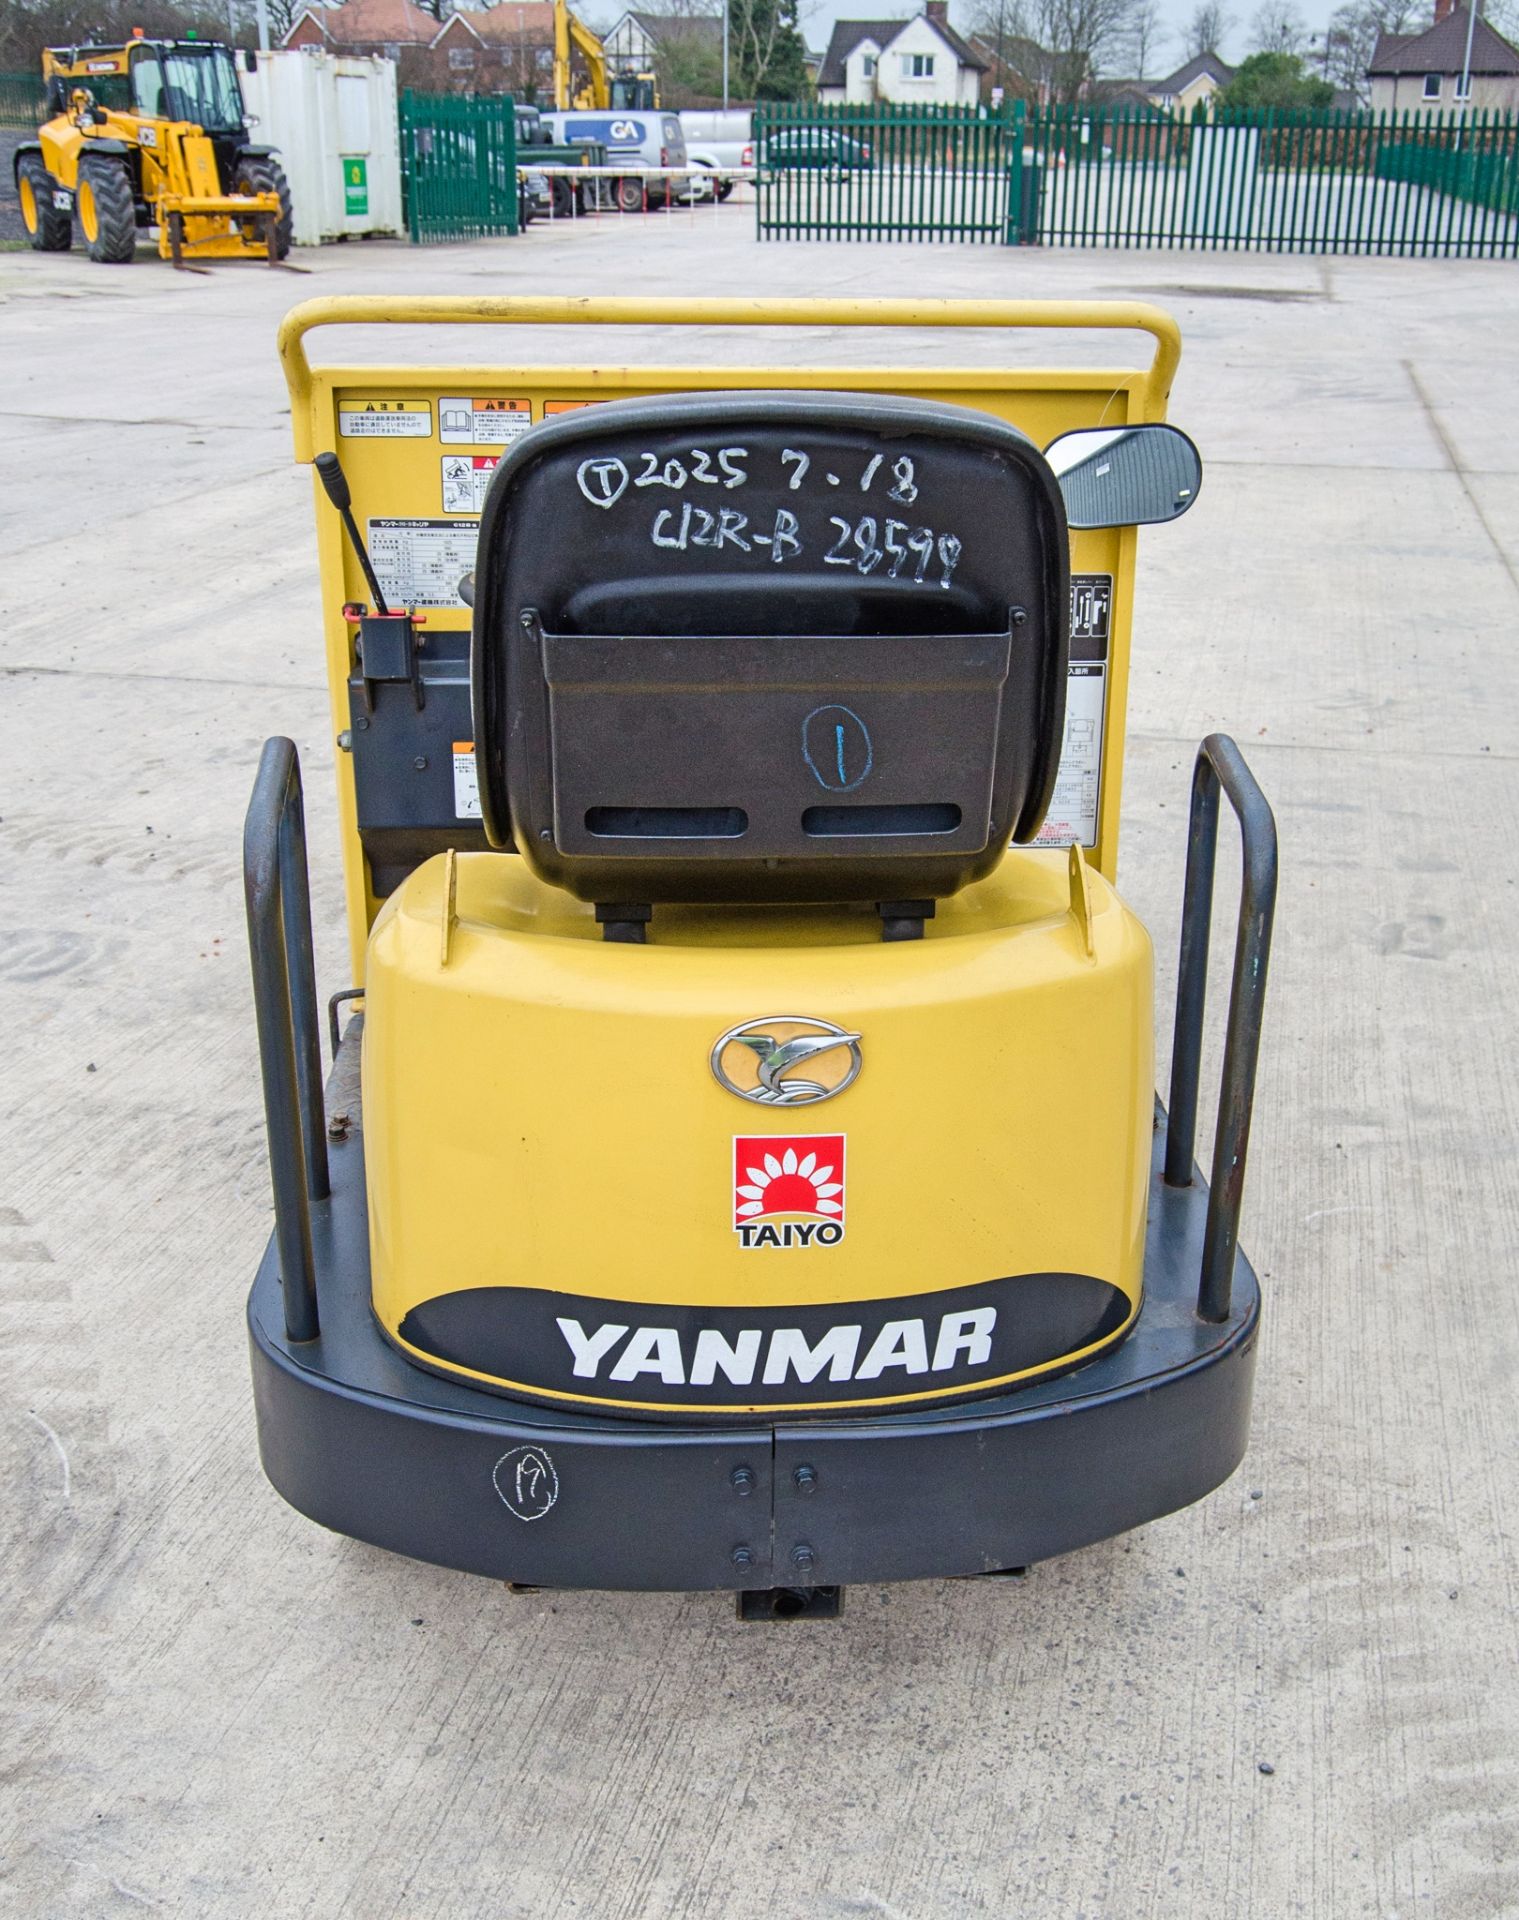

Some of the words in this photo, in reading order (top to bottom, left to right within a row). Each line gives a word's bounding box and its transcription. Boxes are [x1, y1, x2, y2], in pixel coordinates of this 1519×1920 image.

[633, 448, 748, 489] 2025
[735, 1223, 843, 1247] TAIYO
[555, 1306, 997, 1385] YANMAR
